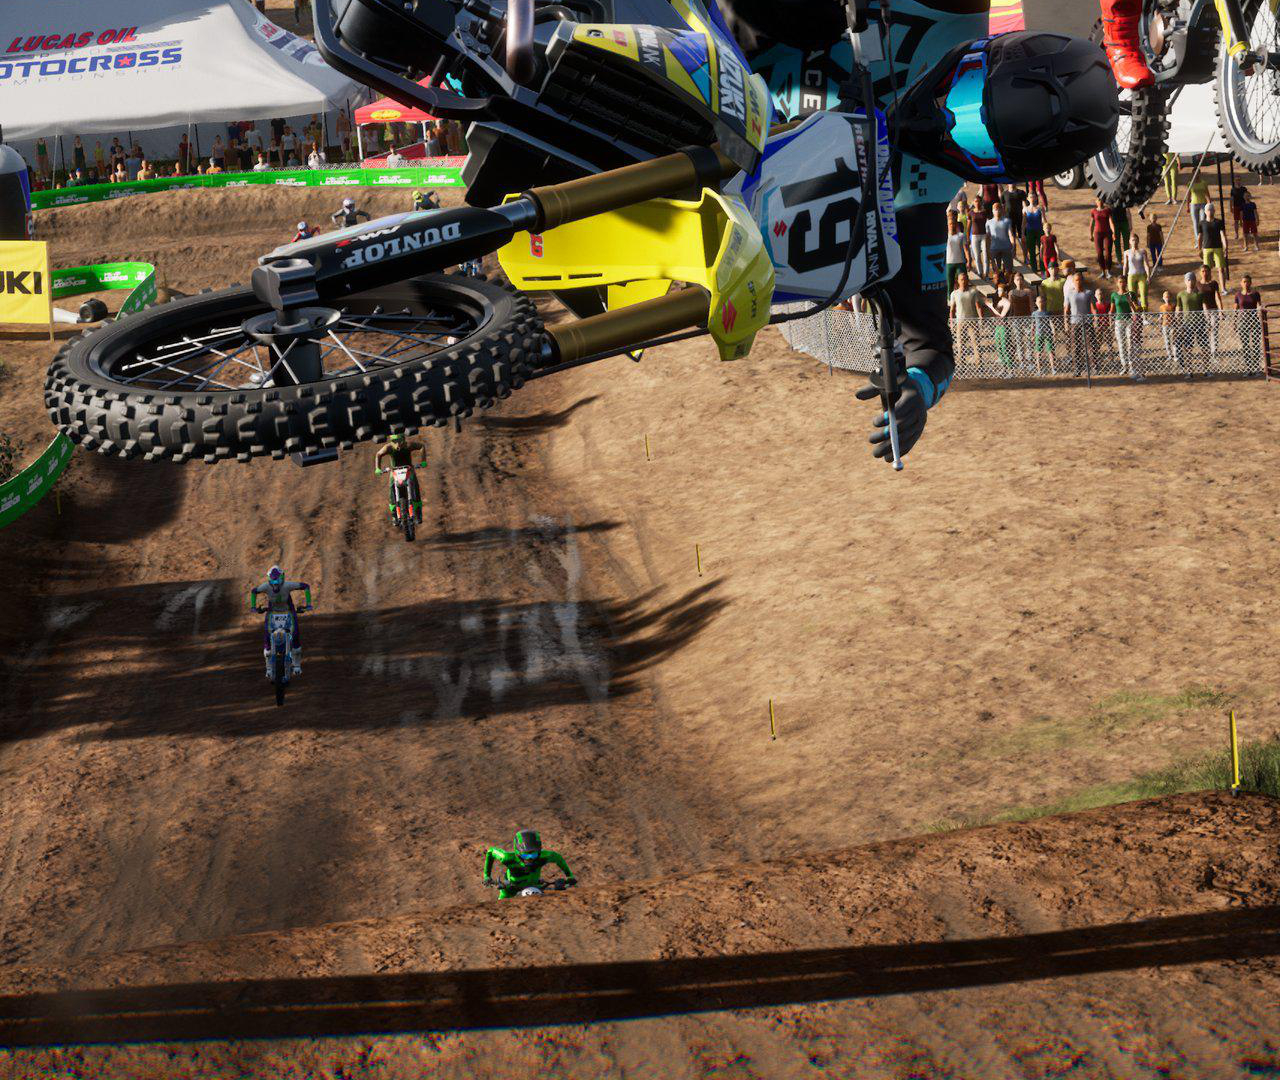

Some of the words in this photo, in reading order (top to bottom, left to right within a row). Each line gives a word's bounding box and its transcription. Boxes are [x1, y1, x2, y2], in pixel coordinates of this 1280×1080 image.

[6, 31, 92, 53] LUCAS
[97, 26, 139, 46] OIL
[780, 156, 863, 274] 19
[866, 210, 878, 254] RIVAL
[345, 222, 462, 269] DUNLOP
[869, 252, 880, 280] INK
